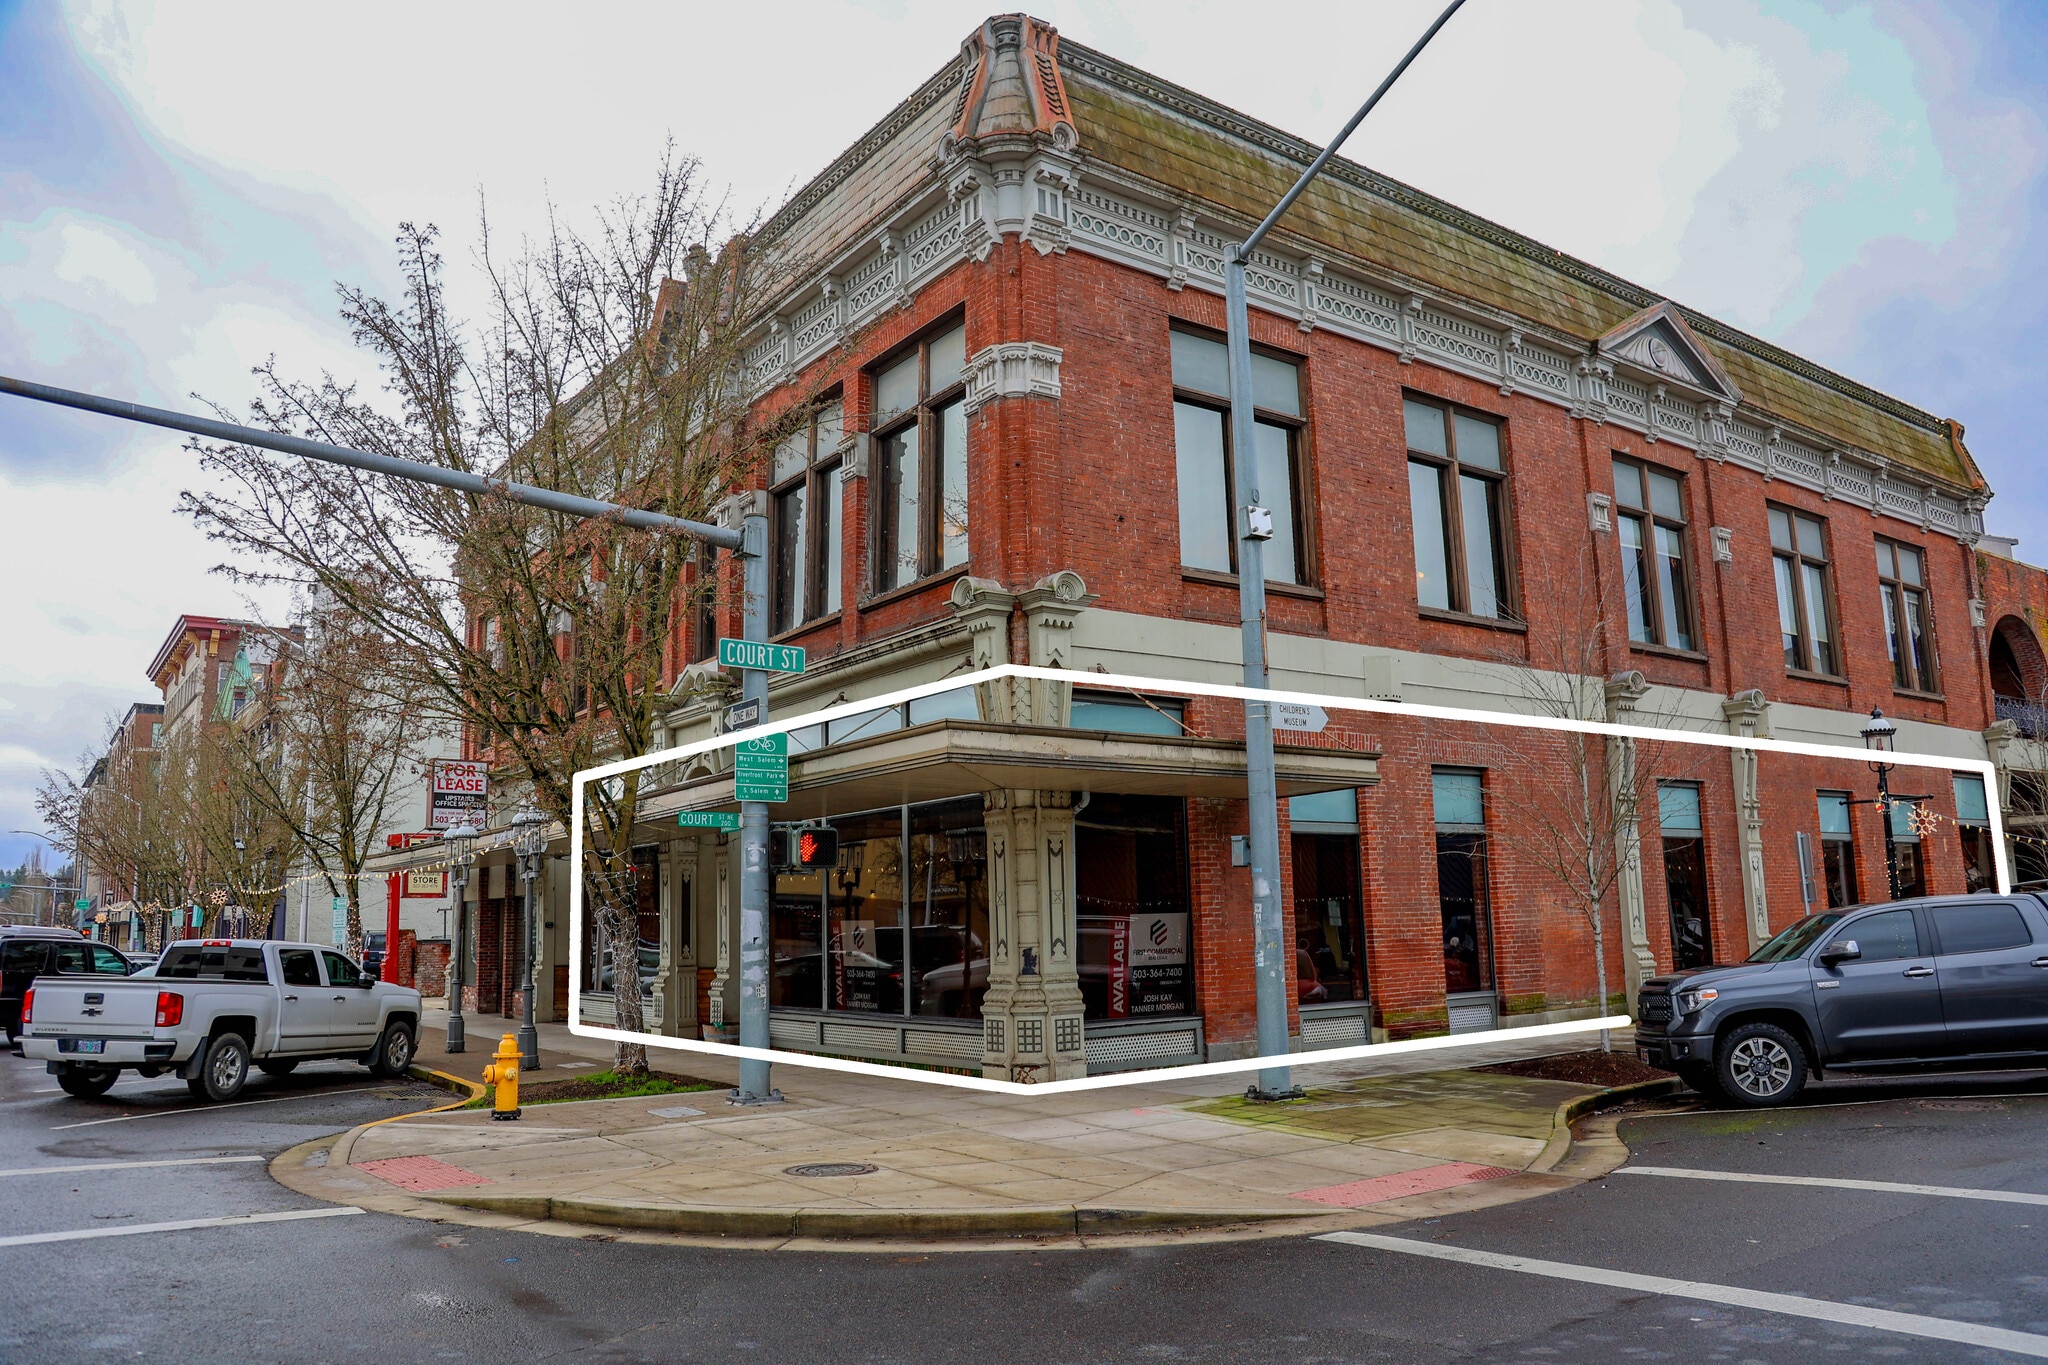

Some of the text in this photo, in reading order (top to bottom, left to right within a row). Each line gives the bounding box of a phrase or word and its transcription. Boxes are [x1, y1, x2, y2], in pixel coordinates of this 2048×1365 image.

[727, 642, 798, 669] COURT ST
[733, 706, 757, 723] ONE WAY
[1279, 704, 1310, 715] CHILDREN'S
[1283, 717, 1307, 727] MUSEUM
[445, 763, 476, 777] FOR
[437, 778, 483, 792] LEASE
[680, 813, 714, 825] COURT
[412, 876, 439, 884] STORE
[1146, 947, 1184, 955] COMMERCIAL
[1112, 921, 1125, 1013] AVAILABLE
[1132, 967, 1183, 979] 503-364-7400
[1143, 993, 1173, 1003] JOSH KAY
[1131, 1003, 1185, 1014] TANNER MORGAN
